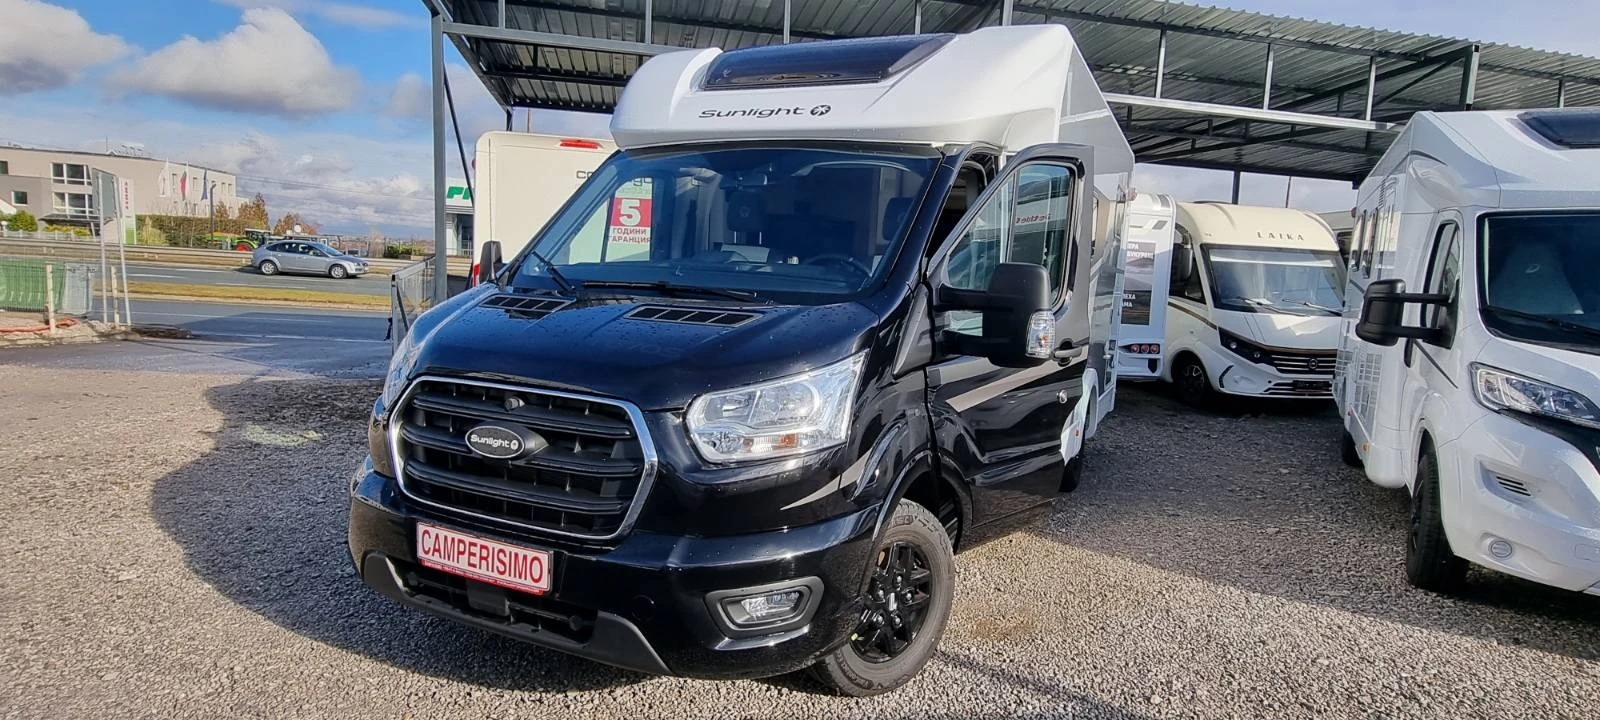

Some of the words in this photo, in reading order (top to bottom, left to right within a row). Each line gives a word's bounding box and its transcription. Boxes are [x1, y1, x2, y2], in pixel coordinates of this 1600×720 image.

[698, 106, 805, 119] Sunlight
[619, 199, 641, 226] 5
[612, 227, 647, 236] ГОДИНИ
[1257, 231, 1304, 241] LAIKA
[610, 236, 651, 244] АРАНЦИЯ
[470, 434, 510, 448] Sunlight
[421, 529, 543, 584] CAMPERISIMO
